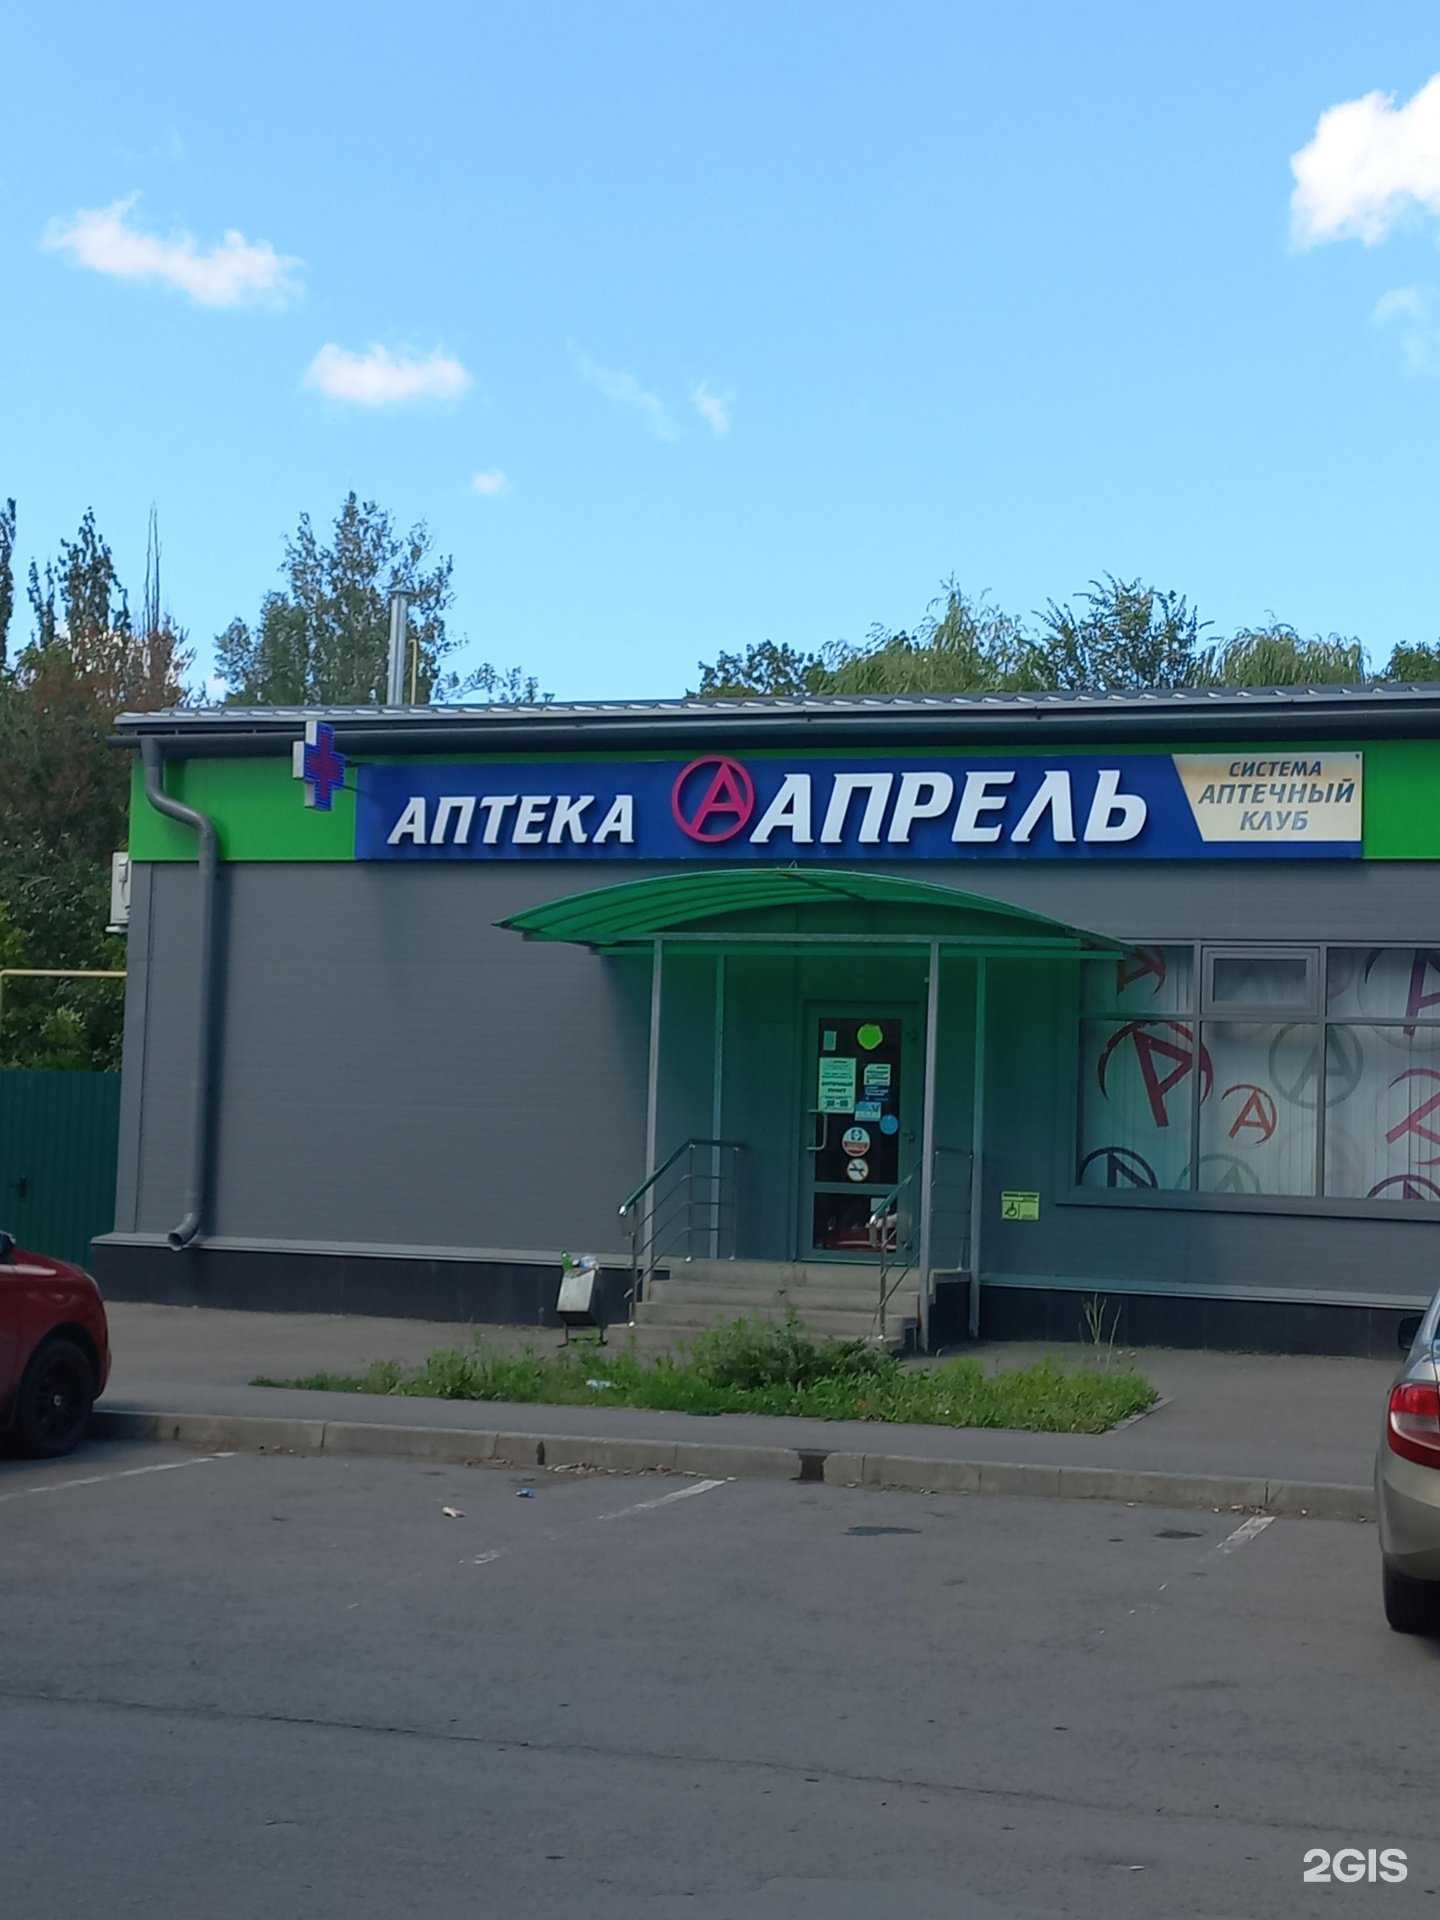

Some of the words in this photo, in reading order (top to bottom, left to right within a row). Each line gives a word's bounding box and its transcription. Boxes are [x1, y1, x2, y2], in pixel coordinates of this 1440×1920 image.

[1228, 760, 1322, 778] СИСТЕМА
[1198, 778, 1355, 804] АПТЕЧНЫЙ
[386, 794, 634, 845] АПТЕКА
[749, 769, 1148, 844] АПРЕЛЬ
[1239, 810, 1309, 831] КЛУБ
